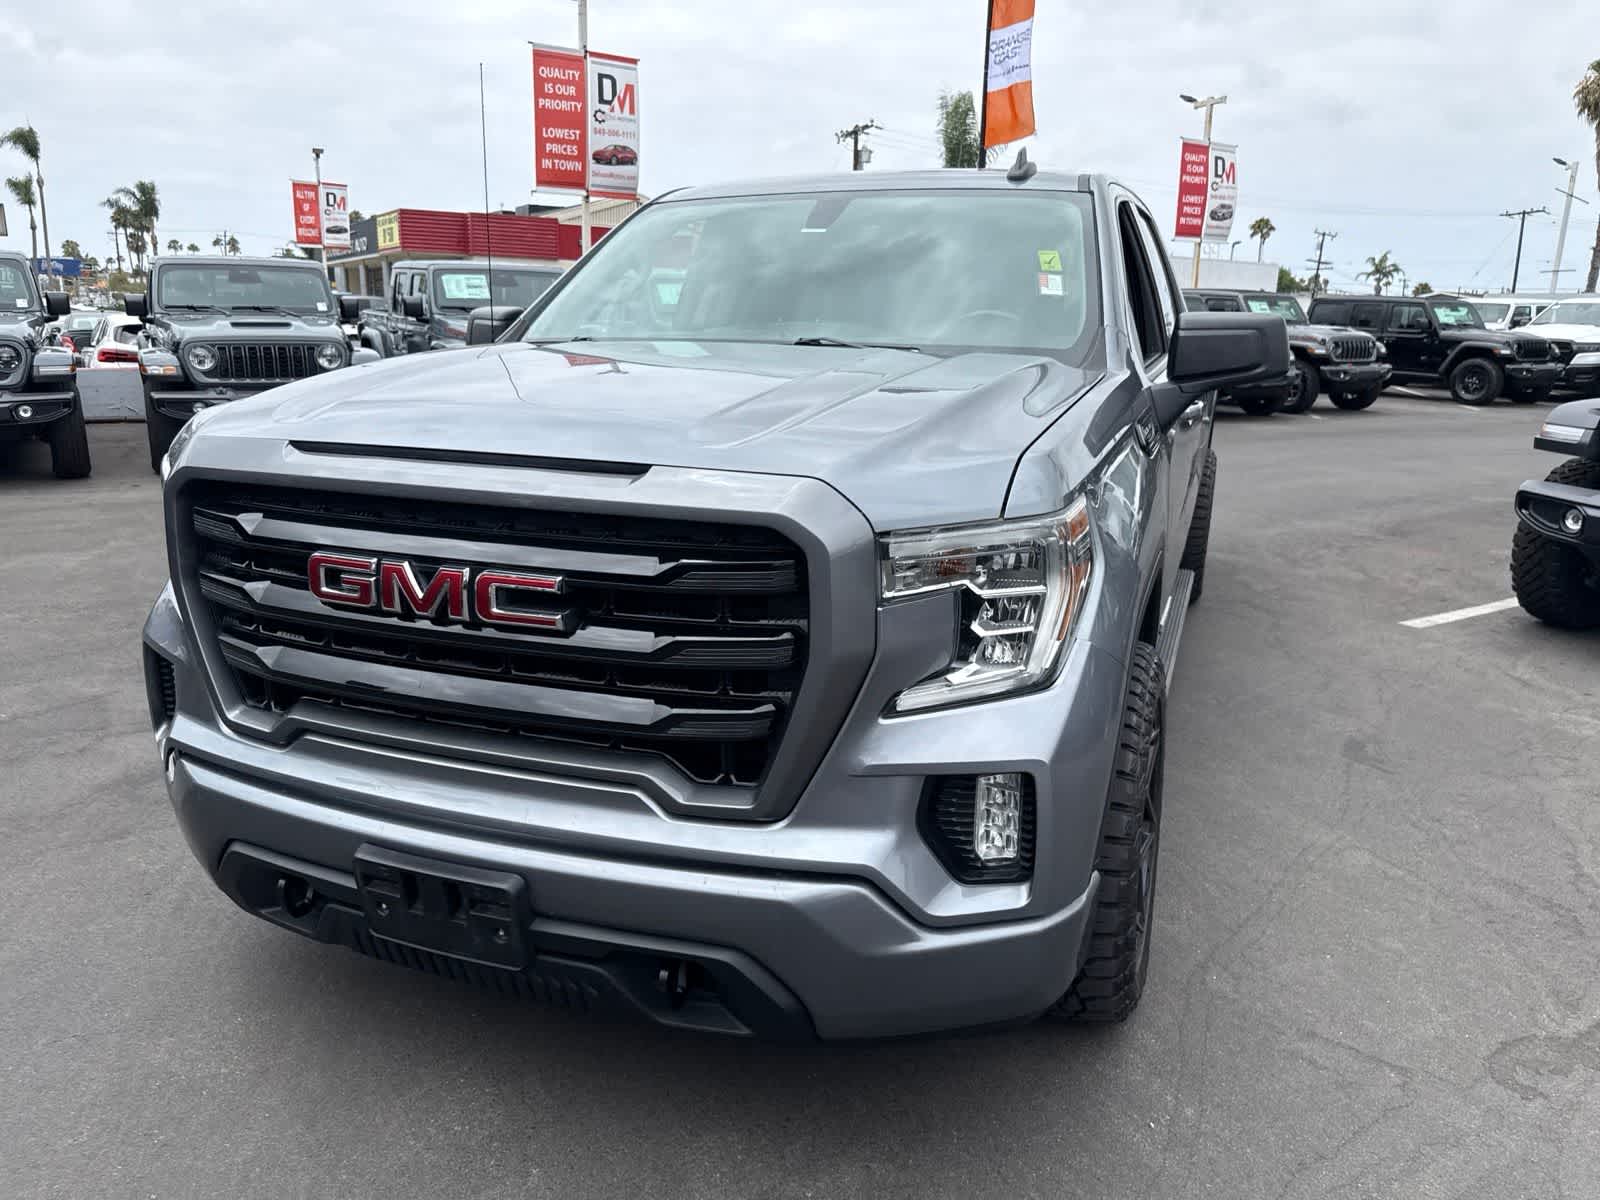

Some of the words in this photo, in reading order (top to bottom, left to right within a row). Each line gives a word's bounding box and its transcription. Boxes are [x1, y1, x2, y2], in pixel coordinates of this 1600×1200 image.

[539, 66, 580, 81] QUALITY
[544, 83, 554, 94] IS
[556, 84, 576, 97] OUR
[539, 98, 582, 113] PRIORITY
[542, 127, 580, 140] LOWEST
[546, 143, 578, 156] PRICES
[1184, 152, 1207, 163] QUALITY
[542, 159, 552, 169] IN
[554, 160, 582, 172] TOWN
[1186, 164, 1192, 172] IS
[1192, 165, 1204, 173] OUR
[1182, 175, 1207, 185] PRIORITY
[1182, 194, 1204, 205] LOWEST
[307, 551, 564, 632] GMC
